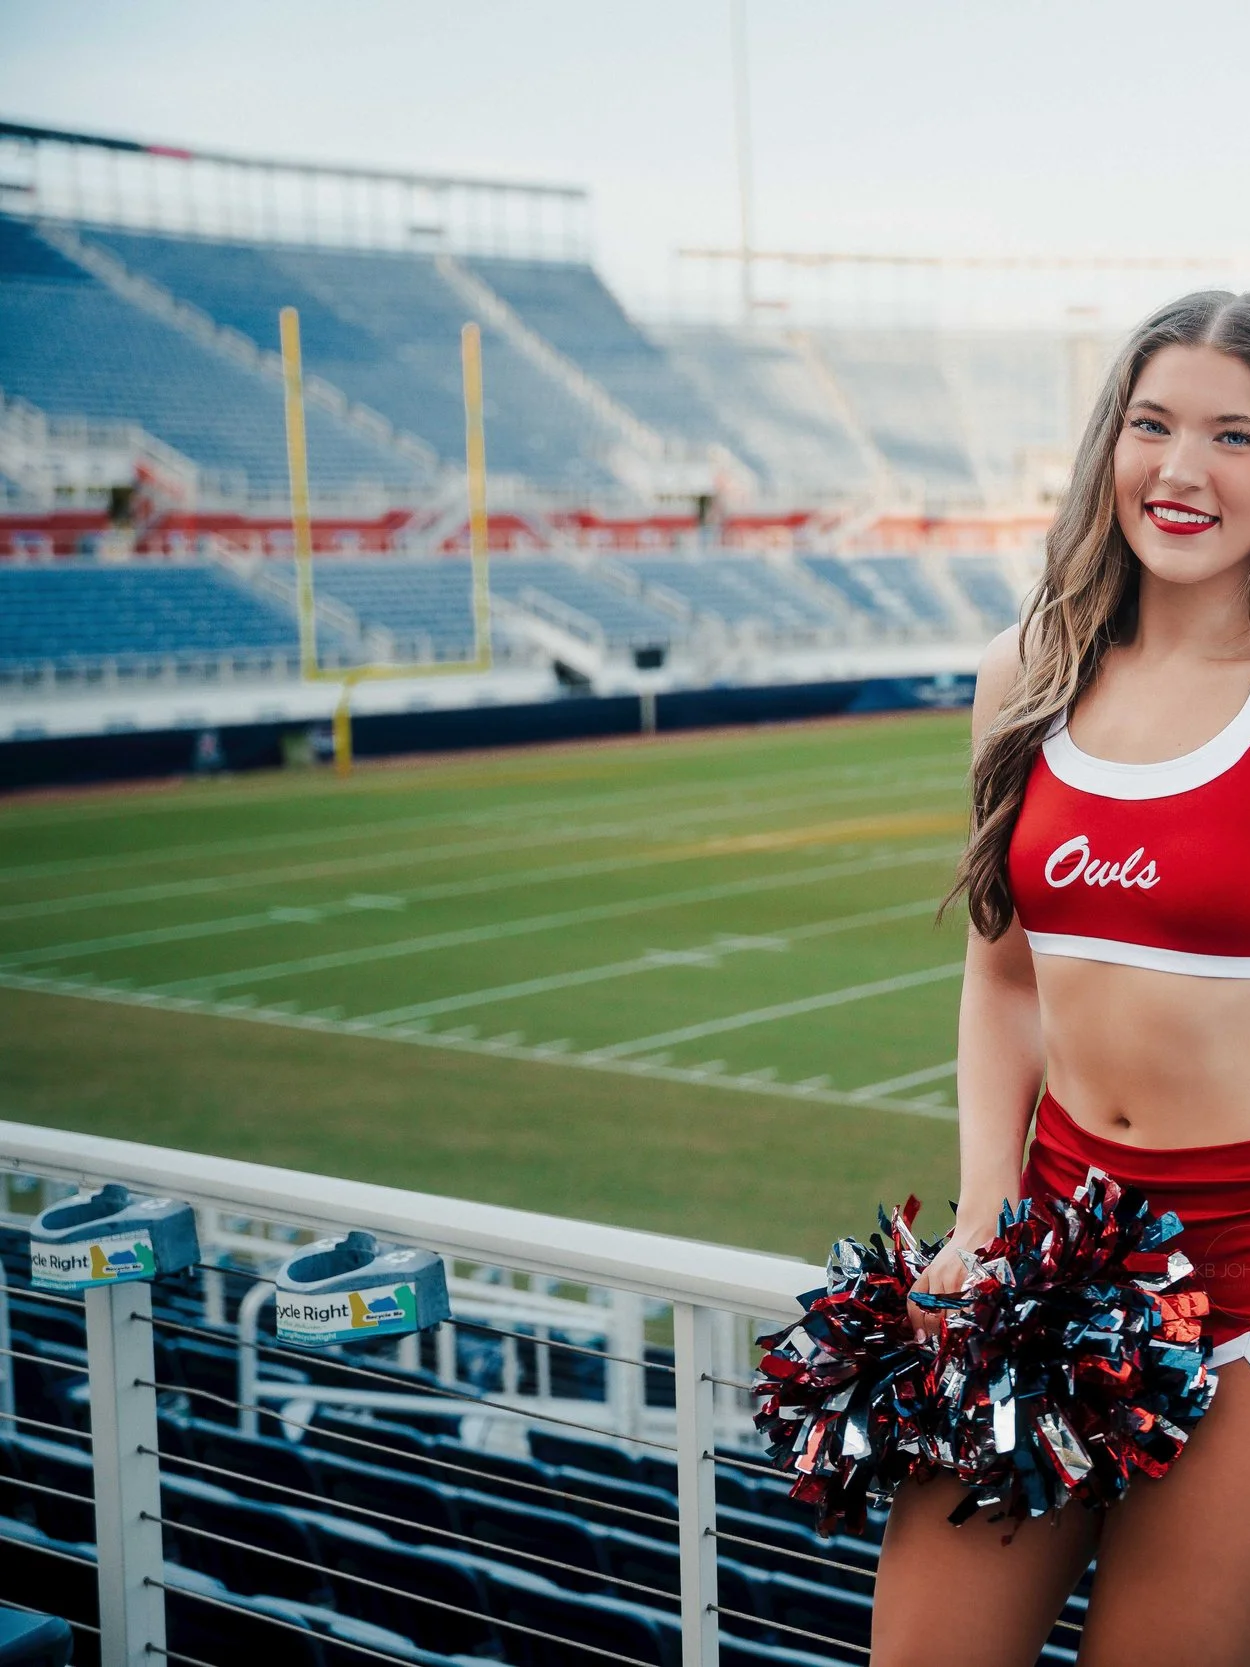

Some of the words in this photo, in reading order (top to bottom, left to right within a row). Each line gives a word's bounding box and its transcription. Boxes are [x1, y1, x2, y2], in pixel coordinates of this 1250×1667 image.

[1045, 835, 1160, 889] Owls
[49, 1255, 88, 1272] Right
[303, 1304, 349, 1322] Right
